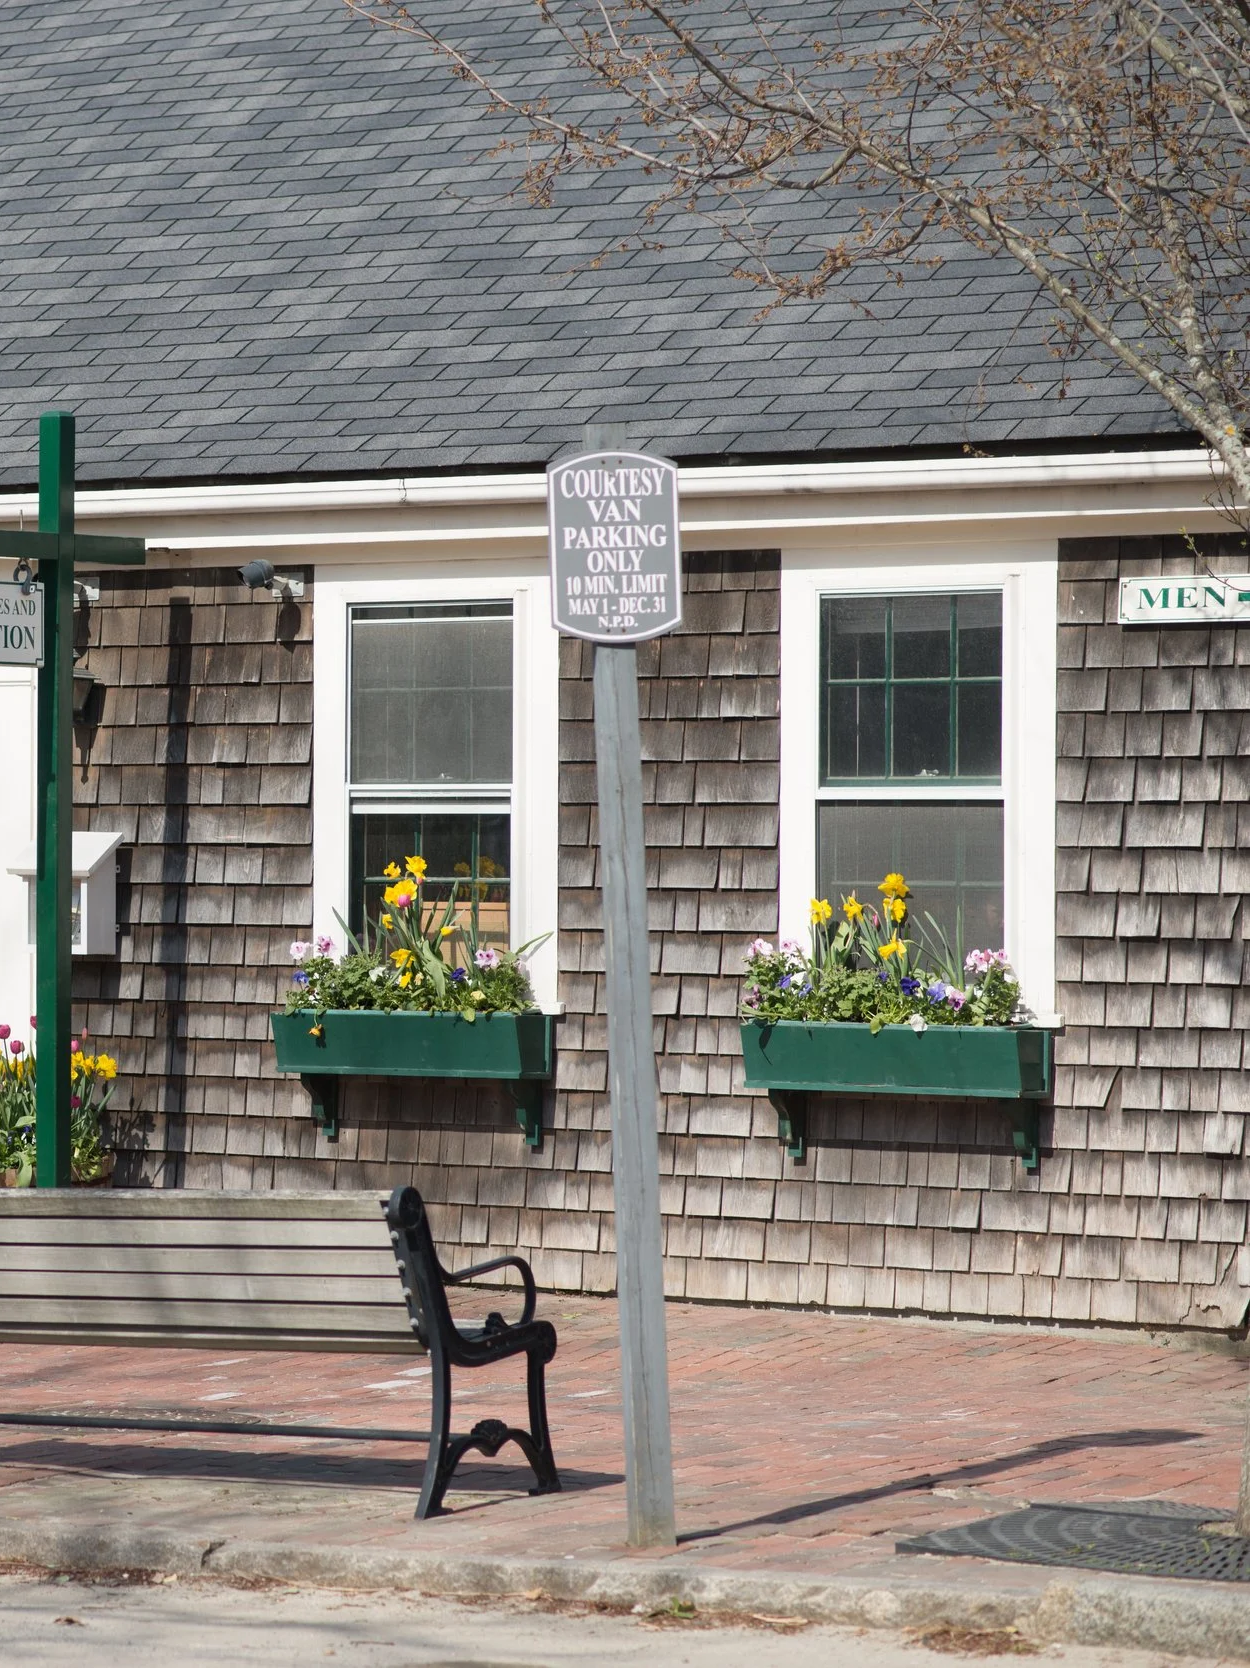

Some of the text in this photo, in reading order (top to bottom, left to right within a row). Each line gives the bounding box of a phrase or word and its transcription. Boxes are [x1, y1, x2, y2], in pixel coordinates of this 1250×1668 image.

[587, 499, 642, 522] VAN
[562, 524, 668, 550] PARKING
[586, 550, 645, 574] ONLY
[566, 573, 668, 596] 10 MIN. LIMIT
[12, 599, 36, 616] AND
[568, 598, 600, 616] MAY
[602, 598, 609, 615] 1
[619, 597, 651, 614] DEC.
[653, 596, 667, 613] 31
[1137, 586, 1227, 610] MEN
[598, 616, 639, 628] N.P.D.
